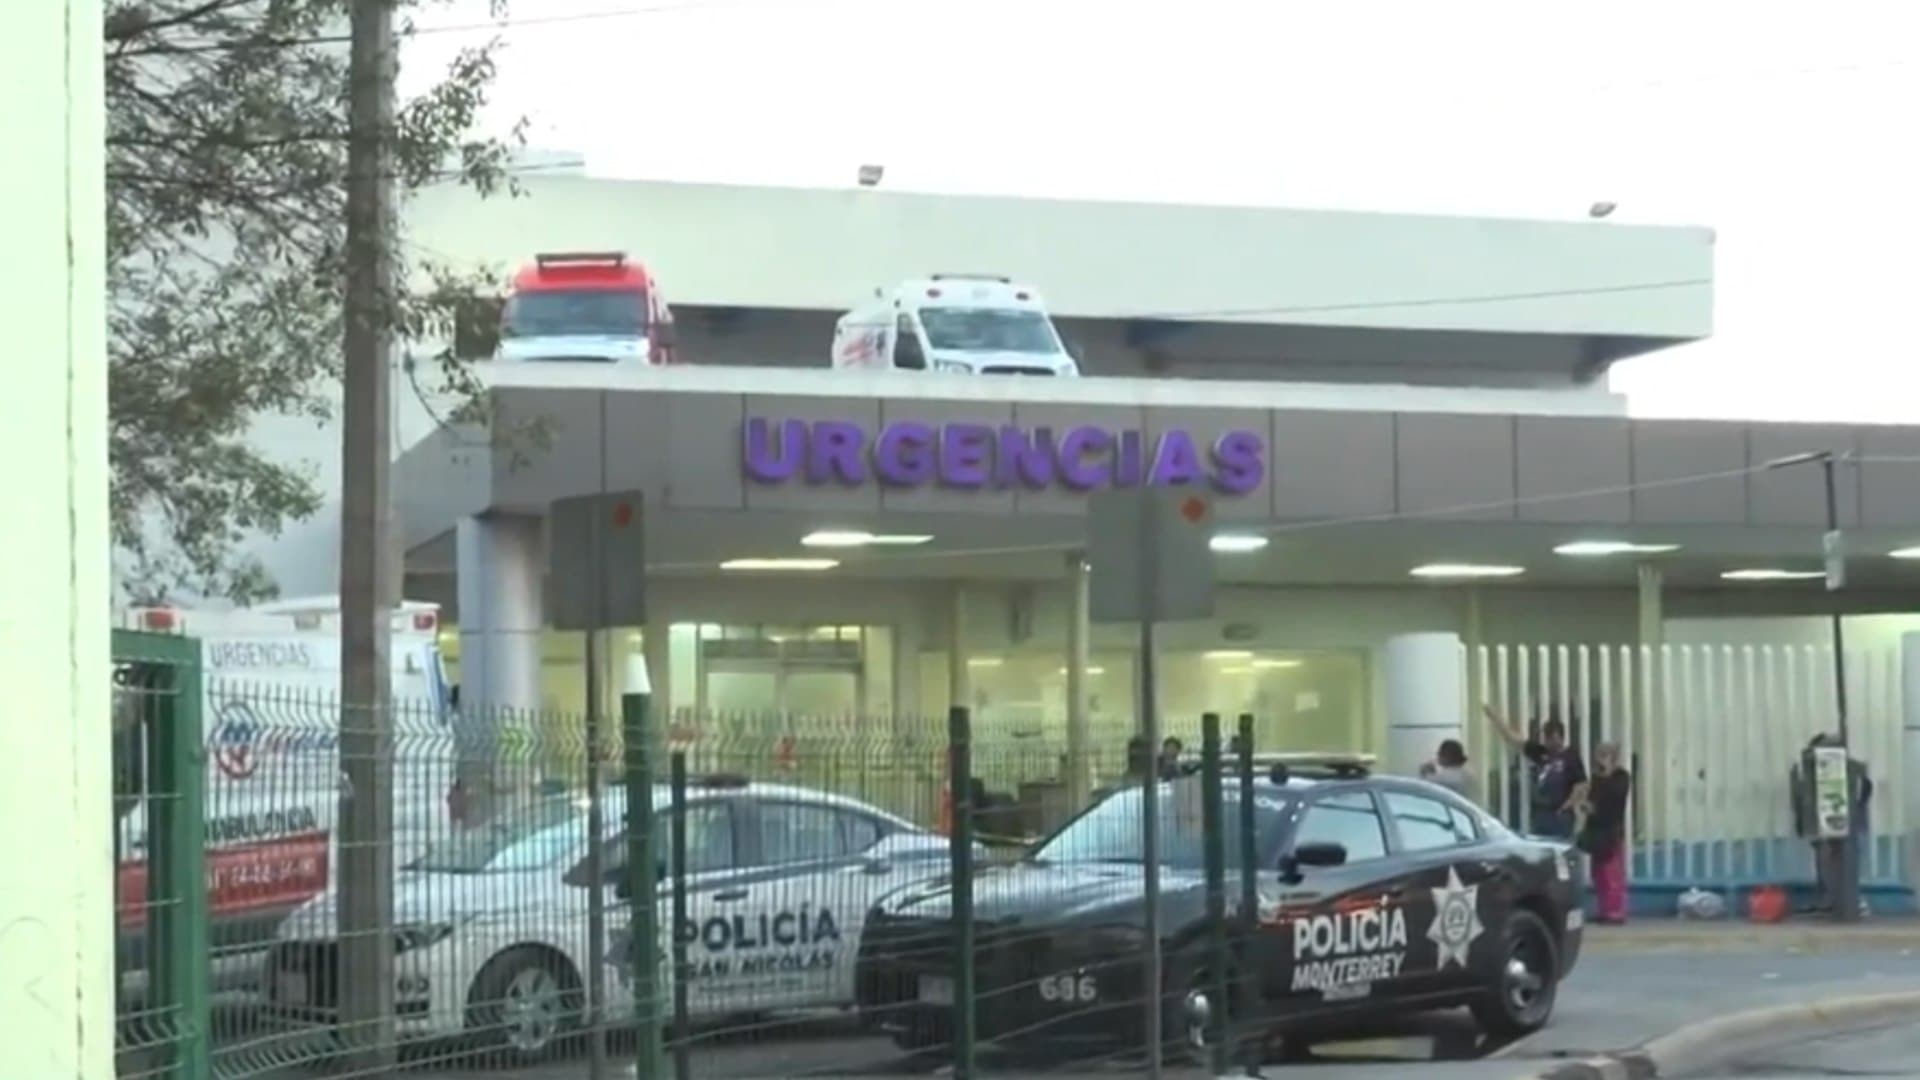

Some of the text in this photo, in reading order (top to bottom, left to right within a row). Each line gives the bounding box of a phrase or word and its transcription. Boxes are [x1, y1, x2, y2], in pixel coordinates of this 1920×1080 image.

[745, 418, 1265, 493] URGENCIAS
[210, 641, 311, 667] URGENCIAS
[1293, 894, 1407, 960] POLICÍA
[1291, 952, 1405, 992] MONTERREY
